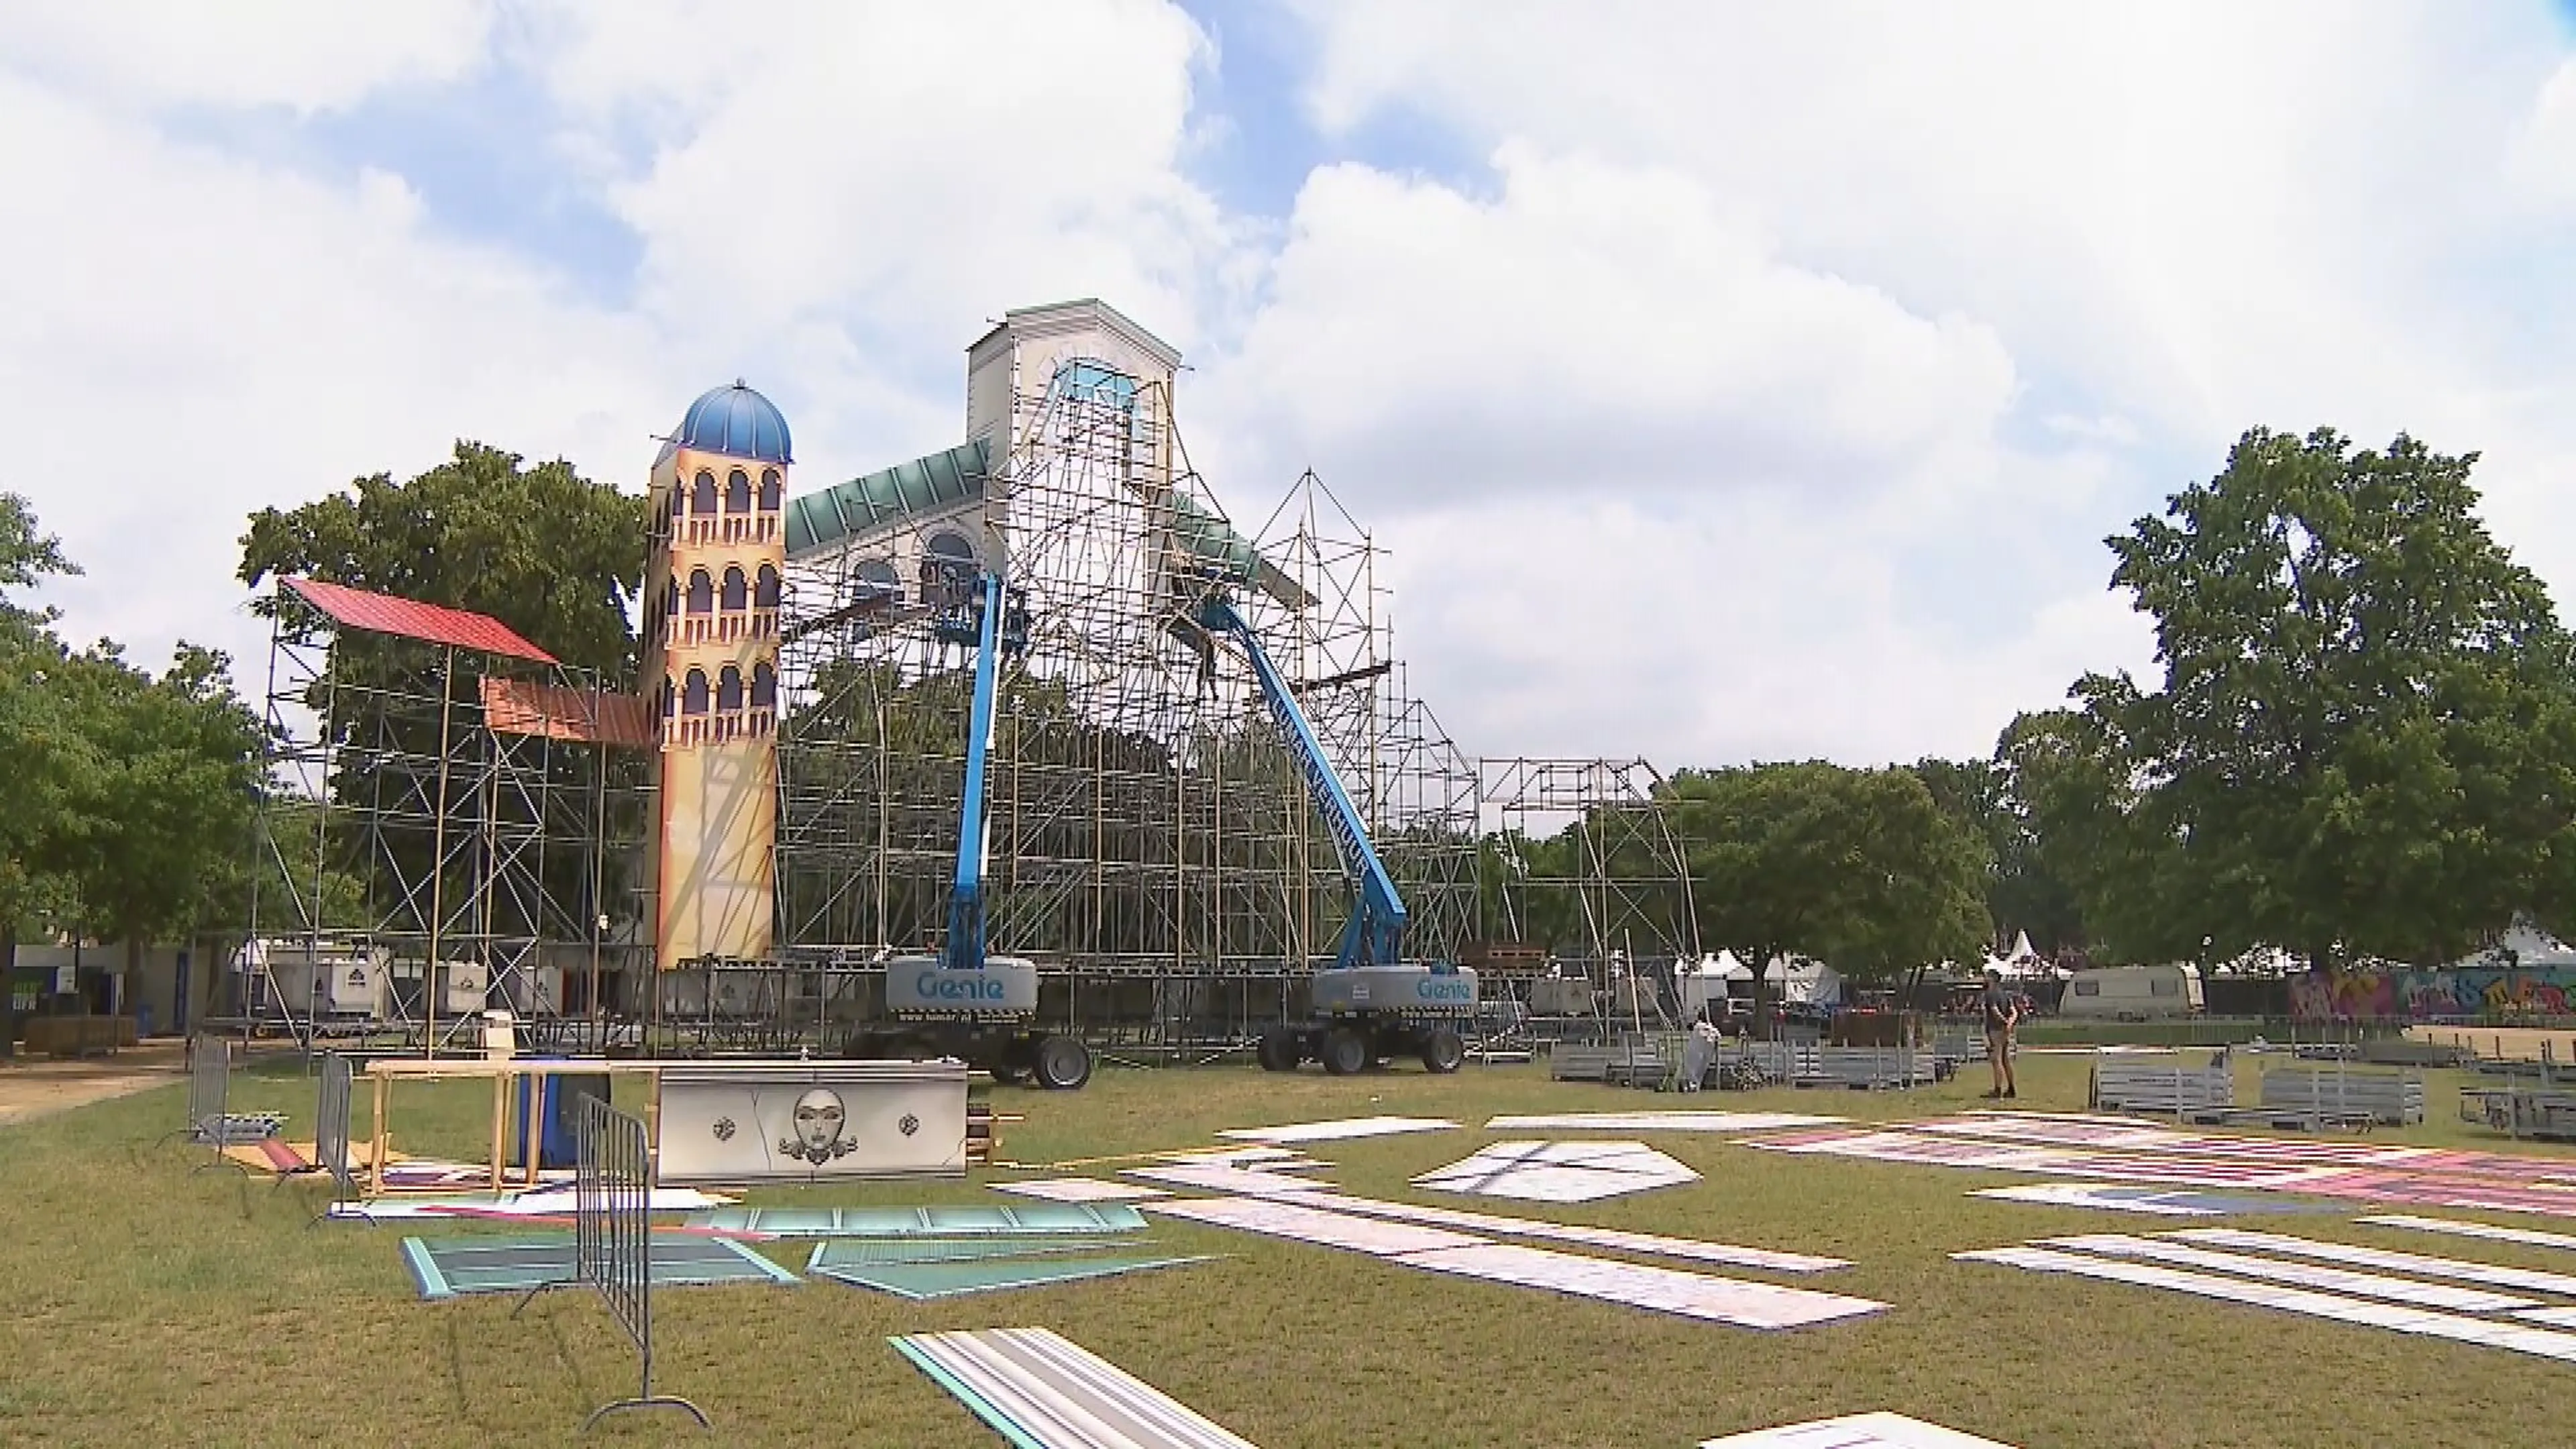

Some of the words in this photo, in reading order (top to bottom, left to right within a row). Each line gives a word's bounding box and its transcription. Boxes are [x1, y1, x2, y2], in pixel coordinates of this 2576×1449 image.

[1312, 769, 1369, 877] VERHUUR
[916, 971, 1004, 999] Genie
[1417, 977, 1471, 1000] Genie
